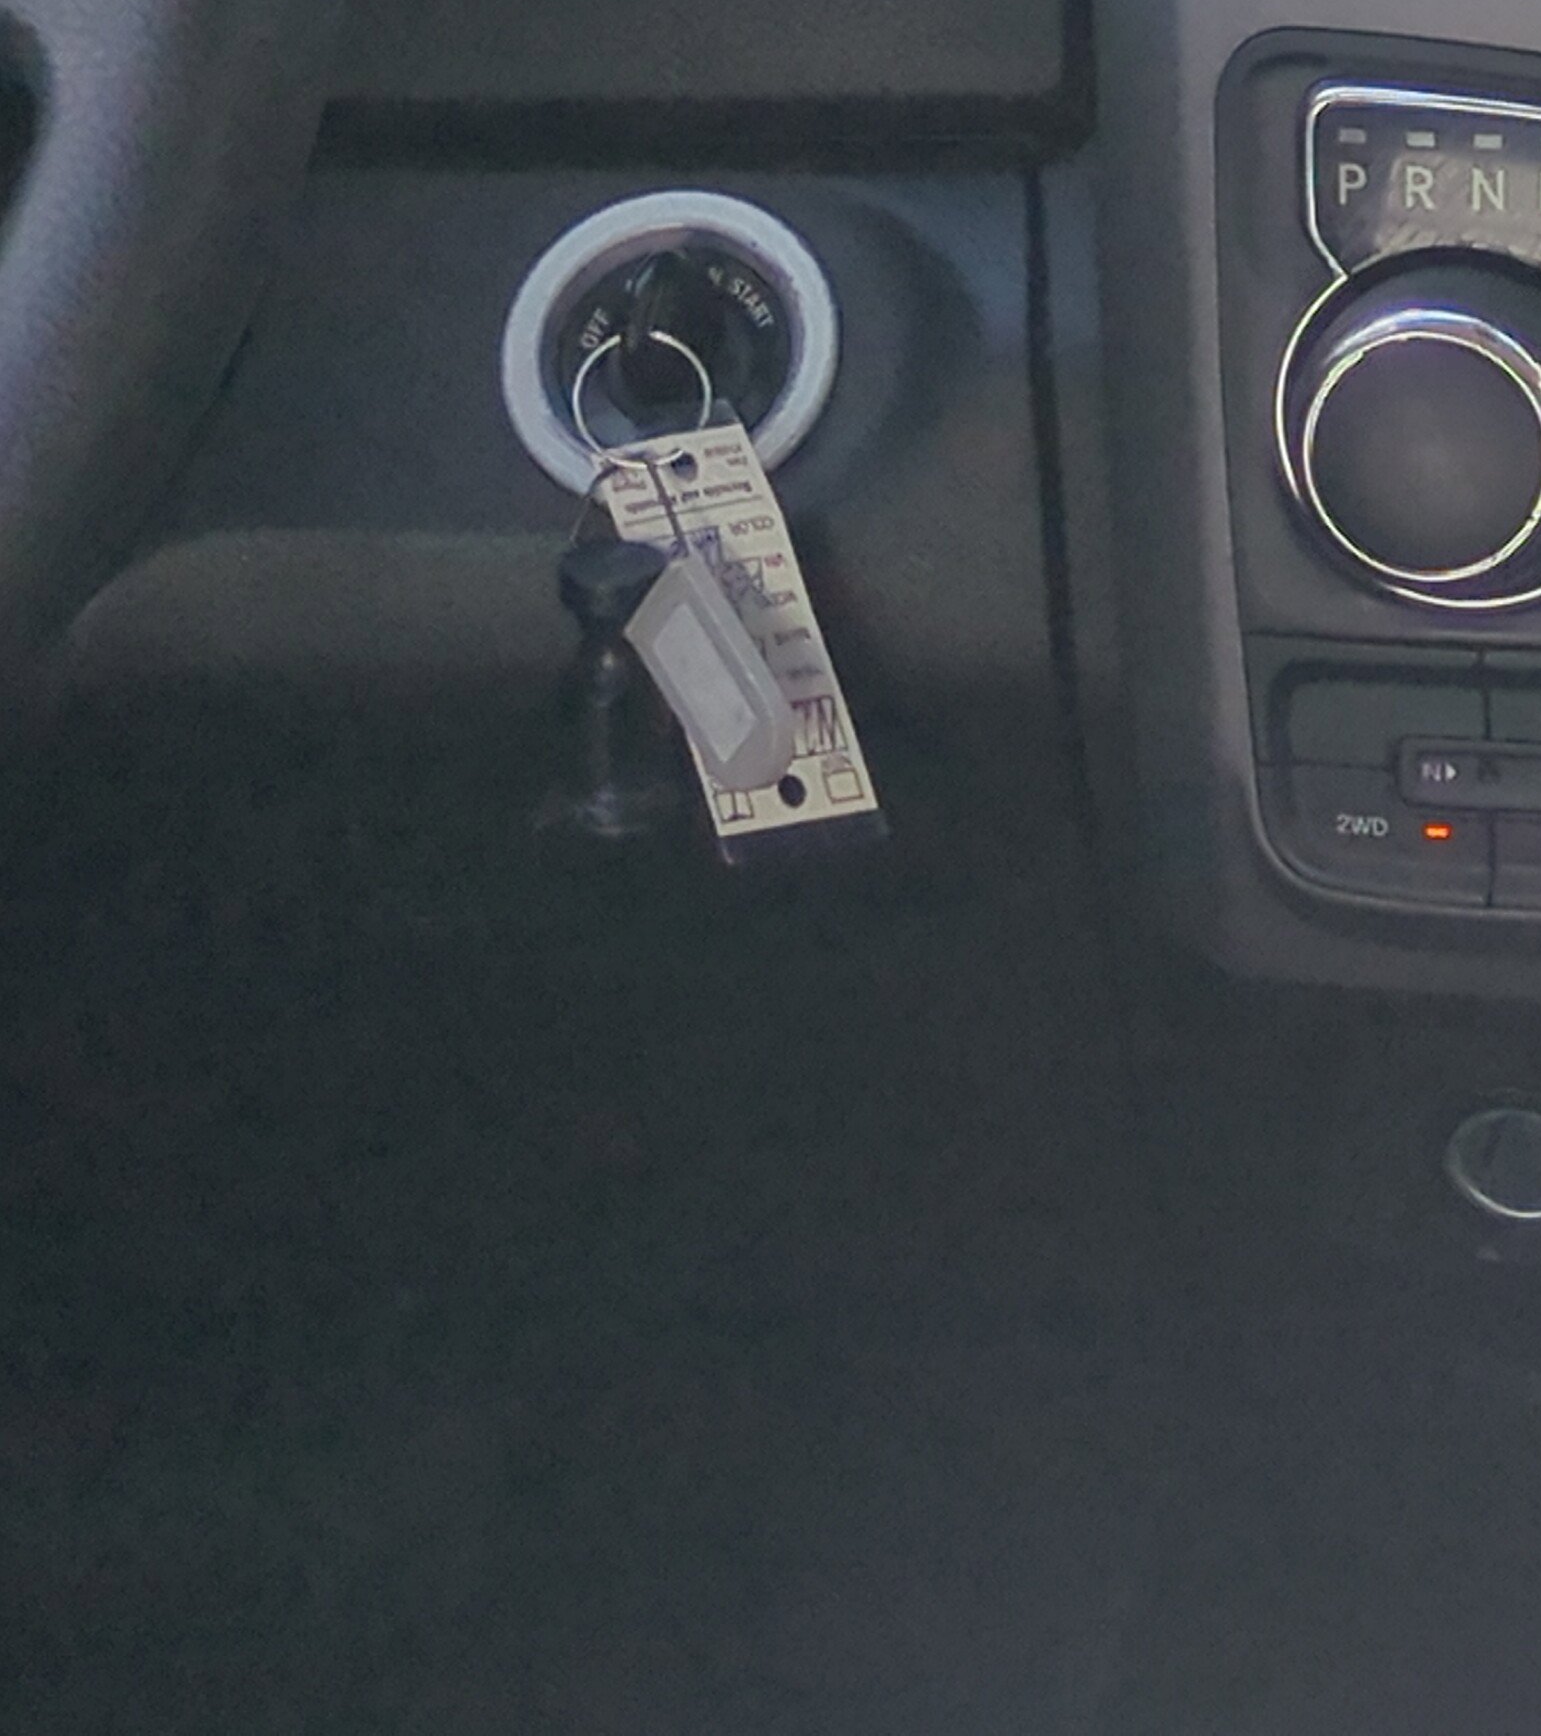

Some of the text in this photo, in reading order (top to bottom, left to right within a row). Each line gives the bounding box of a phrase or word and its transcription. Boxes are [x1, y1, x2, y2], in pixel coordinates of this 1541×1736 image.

[1338, 165, 1368, 205] P
[1403, 166, 1435, 209] R
[1470, 169, 1505, 210] N
[729, 278, 774, 329] START
[579, 308, 611, 350] OFF
[1421, 762, 1443, 782] N
[1335, 814, 1390, 837] 2WD
